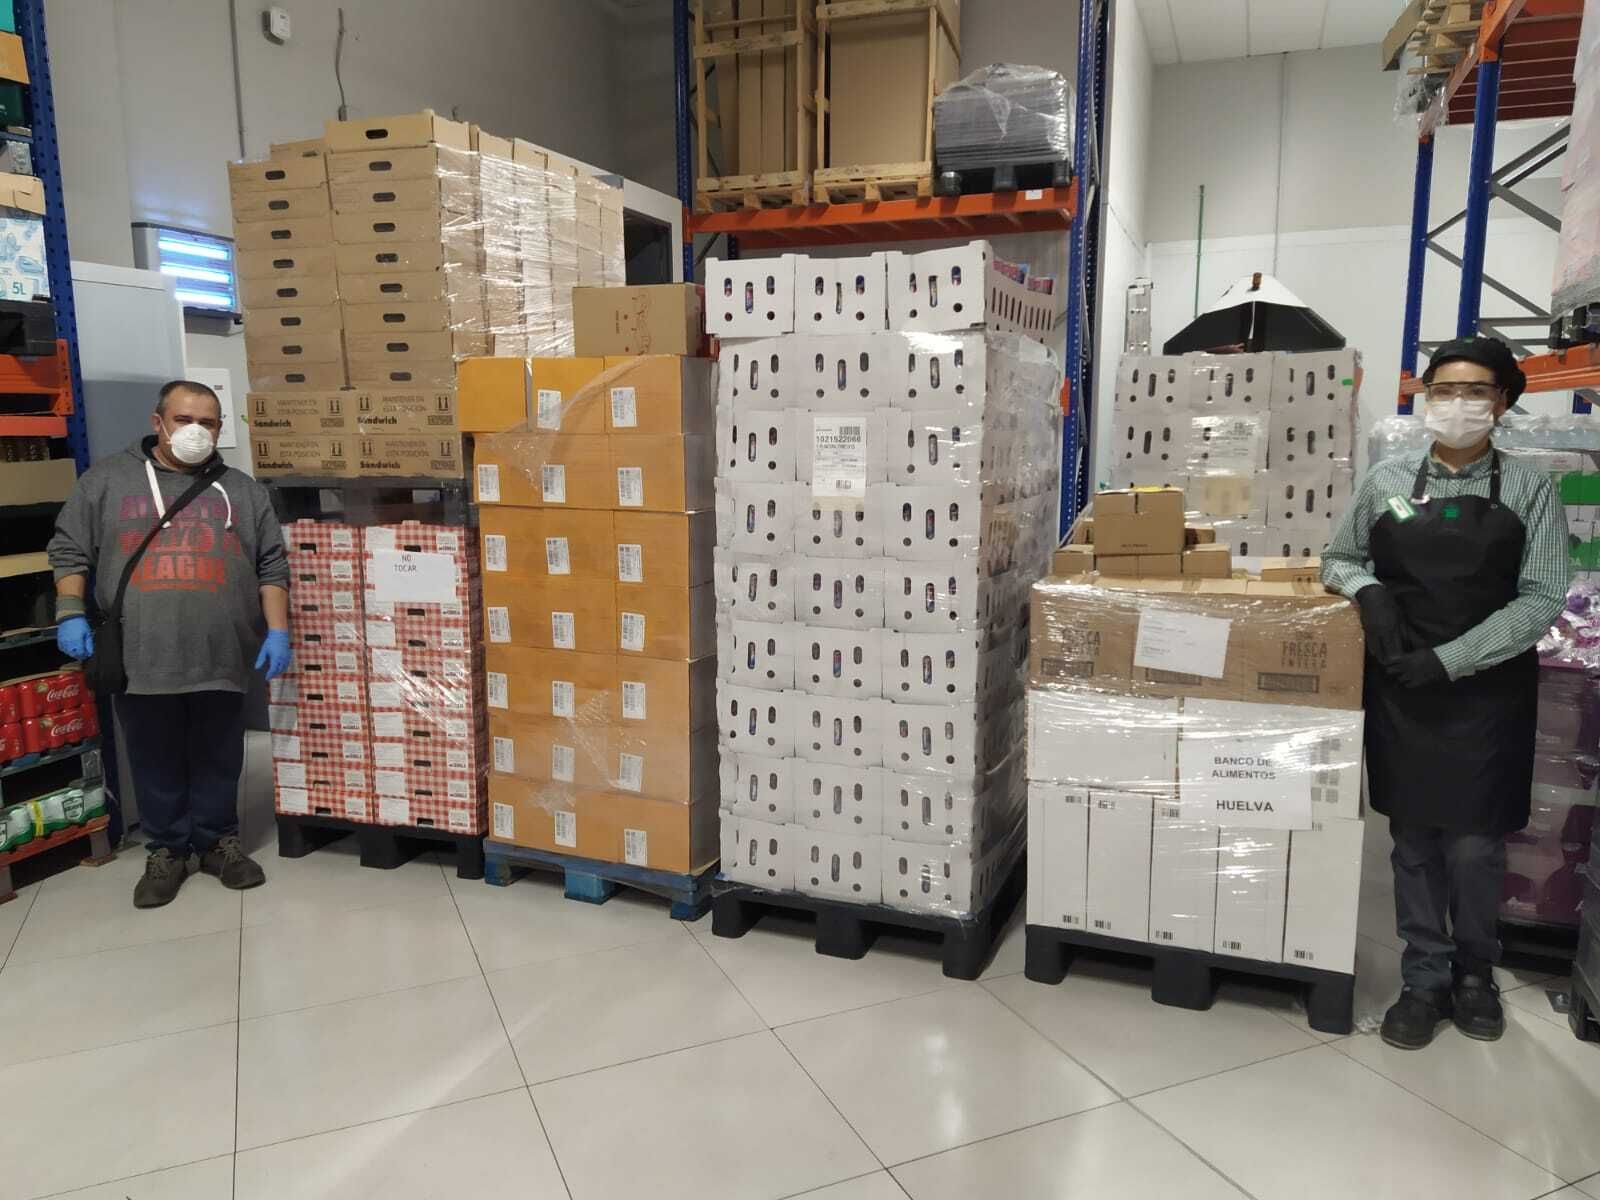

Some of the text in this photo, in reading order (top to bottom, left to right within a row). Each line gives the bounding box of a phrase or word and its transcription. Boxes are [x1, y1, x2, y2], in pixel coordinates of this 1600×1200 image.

[12, 281, 26, 295] 5L
[254, 419, 291, 428] Sandwich
[257, 461, 293, 469] Sandwich
[360, 460, 400, 469] Sandwich
[401, 554, 412, 563] NO
[394, 564, 417, 573] TOCAR
[1282, 640, 1327, 658] FRESCA
[1213, 757, 1272, 767] BANCO DE
[1211, 769, 1276, 780] ALIMENTOS
[1216, 799, 1274, 812] HUELVA
